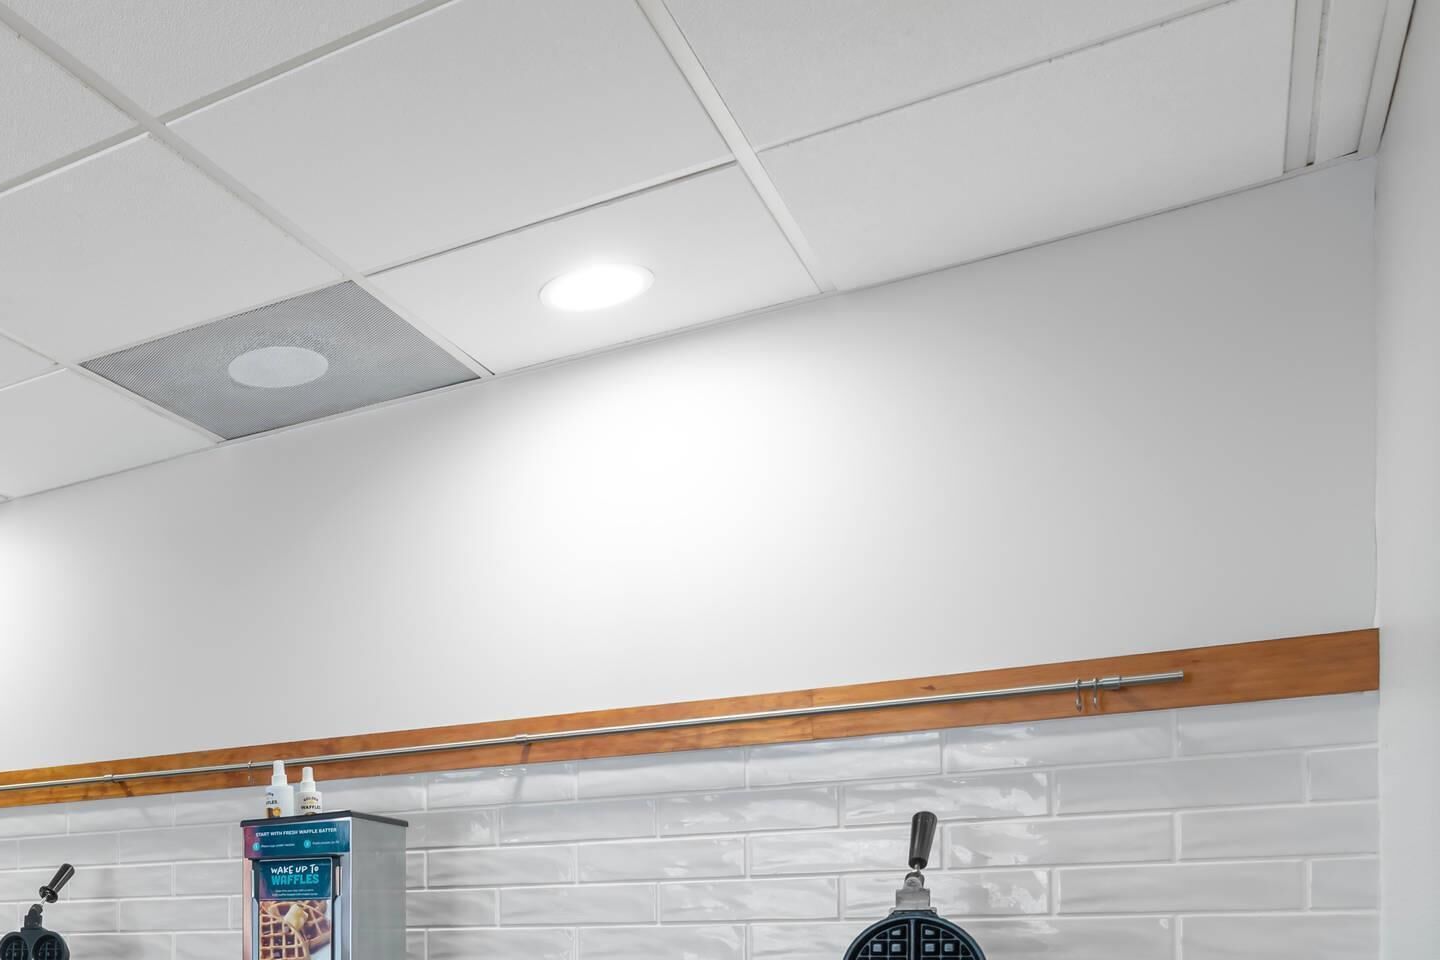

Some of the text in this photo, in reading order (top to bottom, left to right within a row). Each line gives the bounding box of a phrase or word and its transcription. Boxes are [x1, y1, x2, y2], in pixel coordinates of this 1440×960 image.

[270, 865, 294, 875] WAKE
[295, 865, 308, 874] UP
[271, 873, 320, 886] WAFFLES
